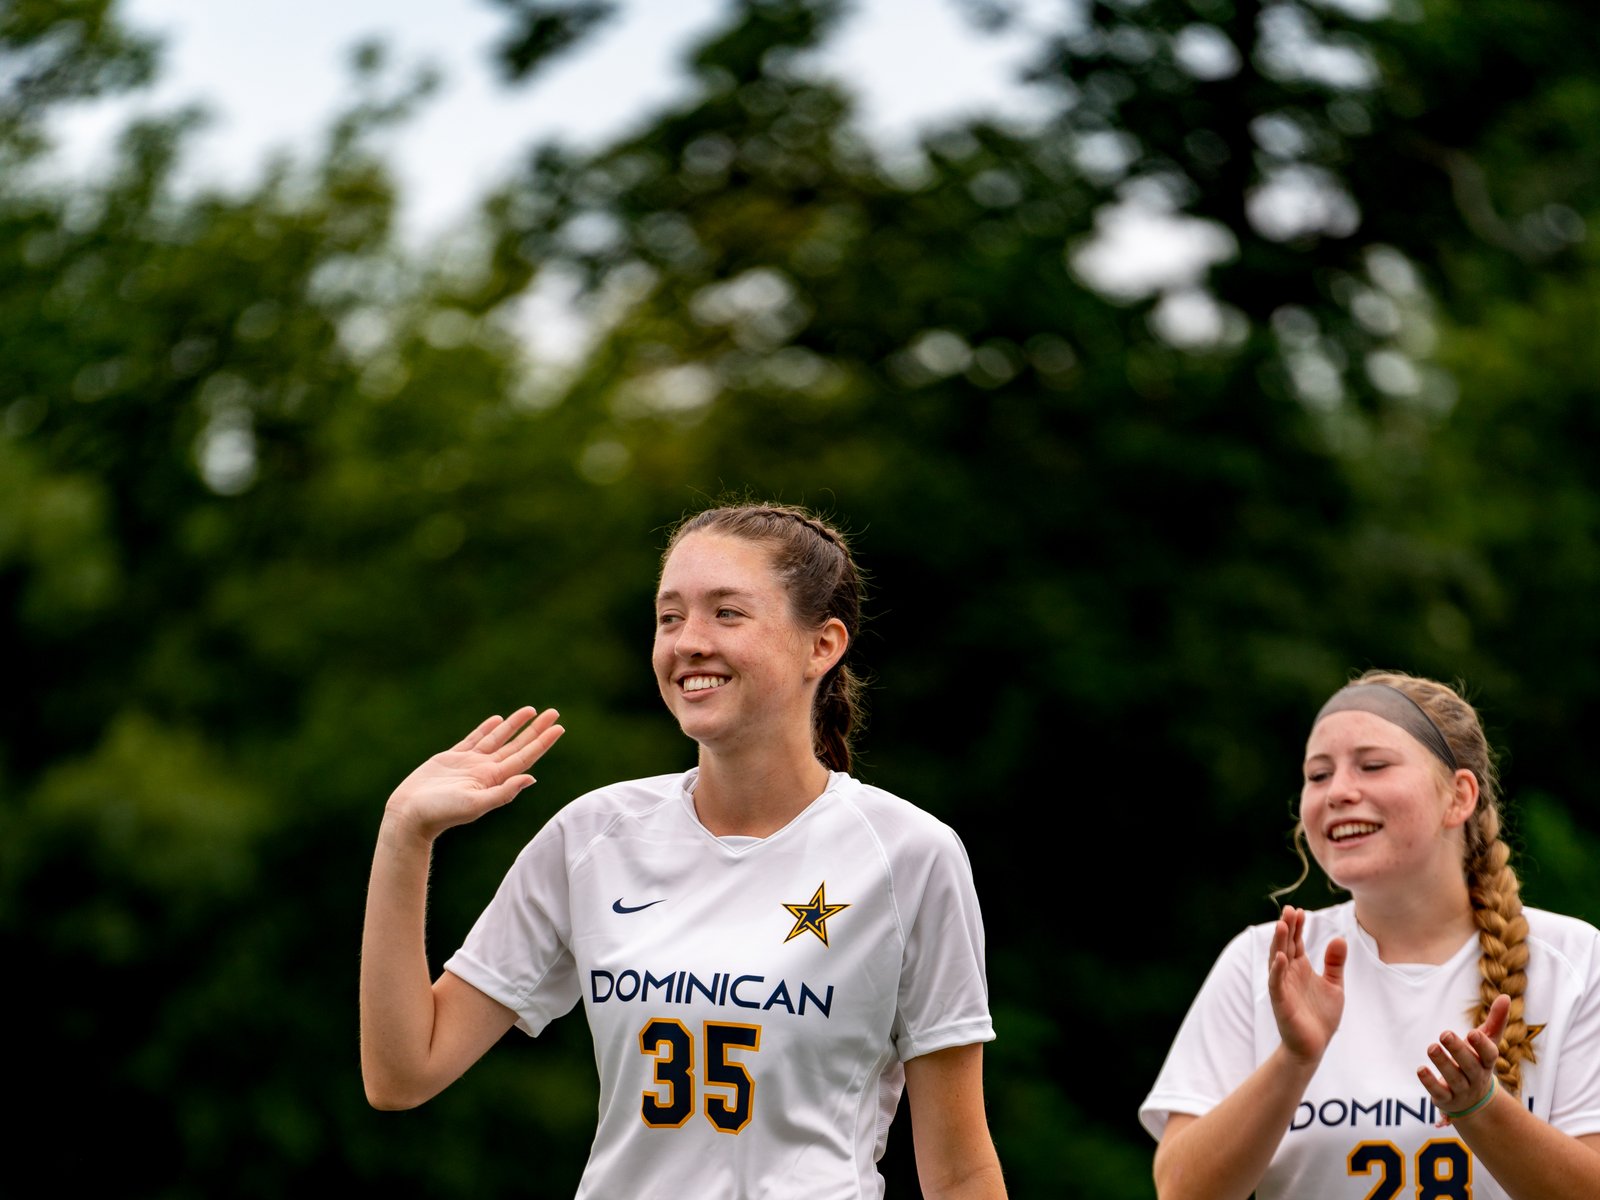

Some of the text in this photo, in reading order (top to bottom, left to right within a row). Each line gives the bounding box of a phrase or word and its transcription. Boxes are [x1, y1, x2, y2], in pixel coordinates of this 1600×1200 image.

[591, 969, 834, 1019] DOMINICAN
[638, 1017, 762, 1136] 35
[1290, 1096, 1534, 1131] DOMINI
